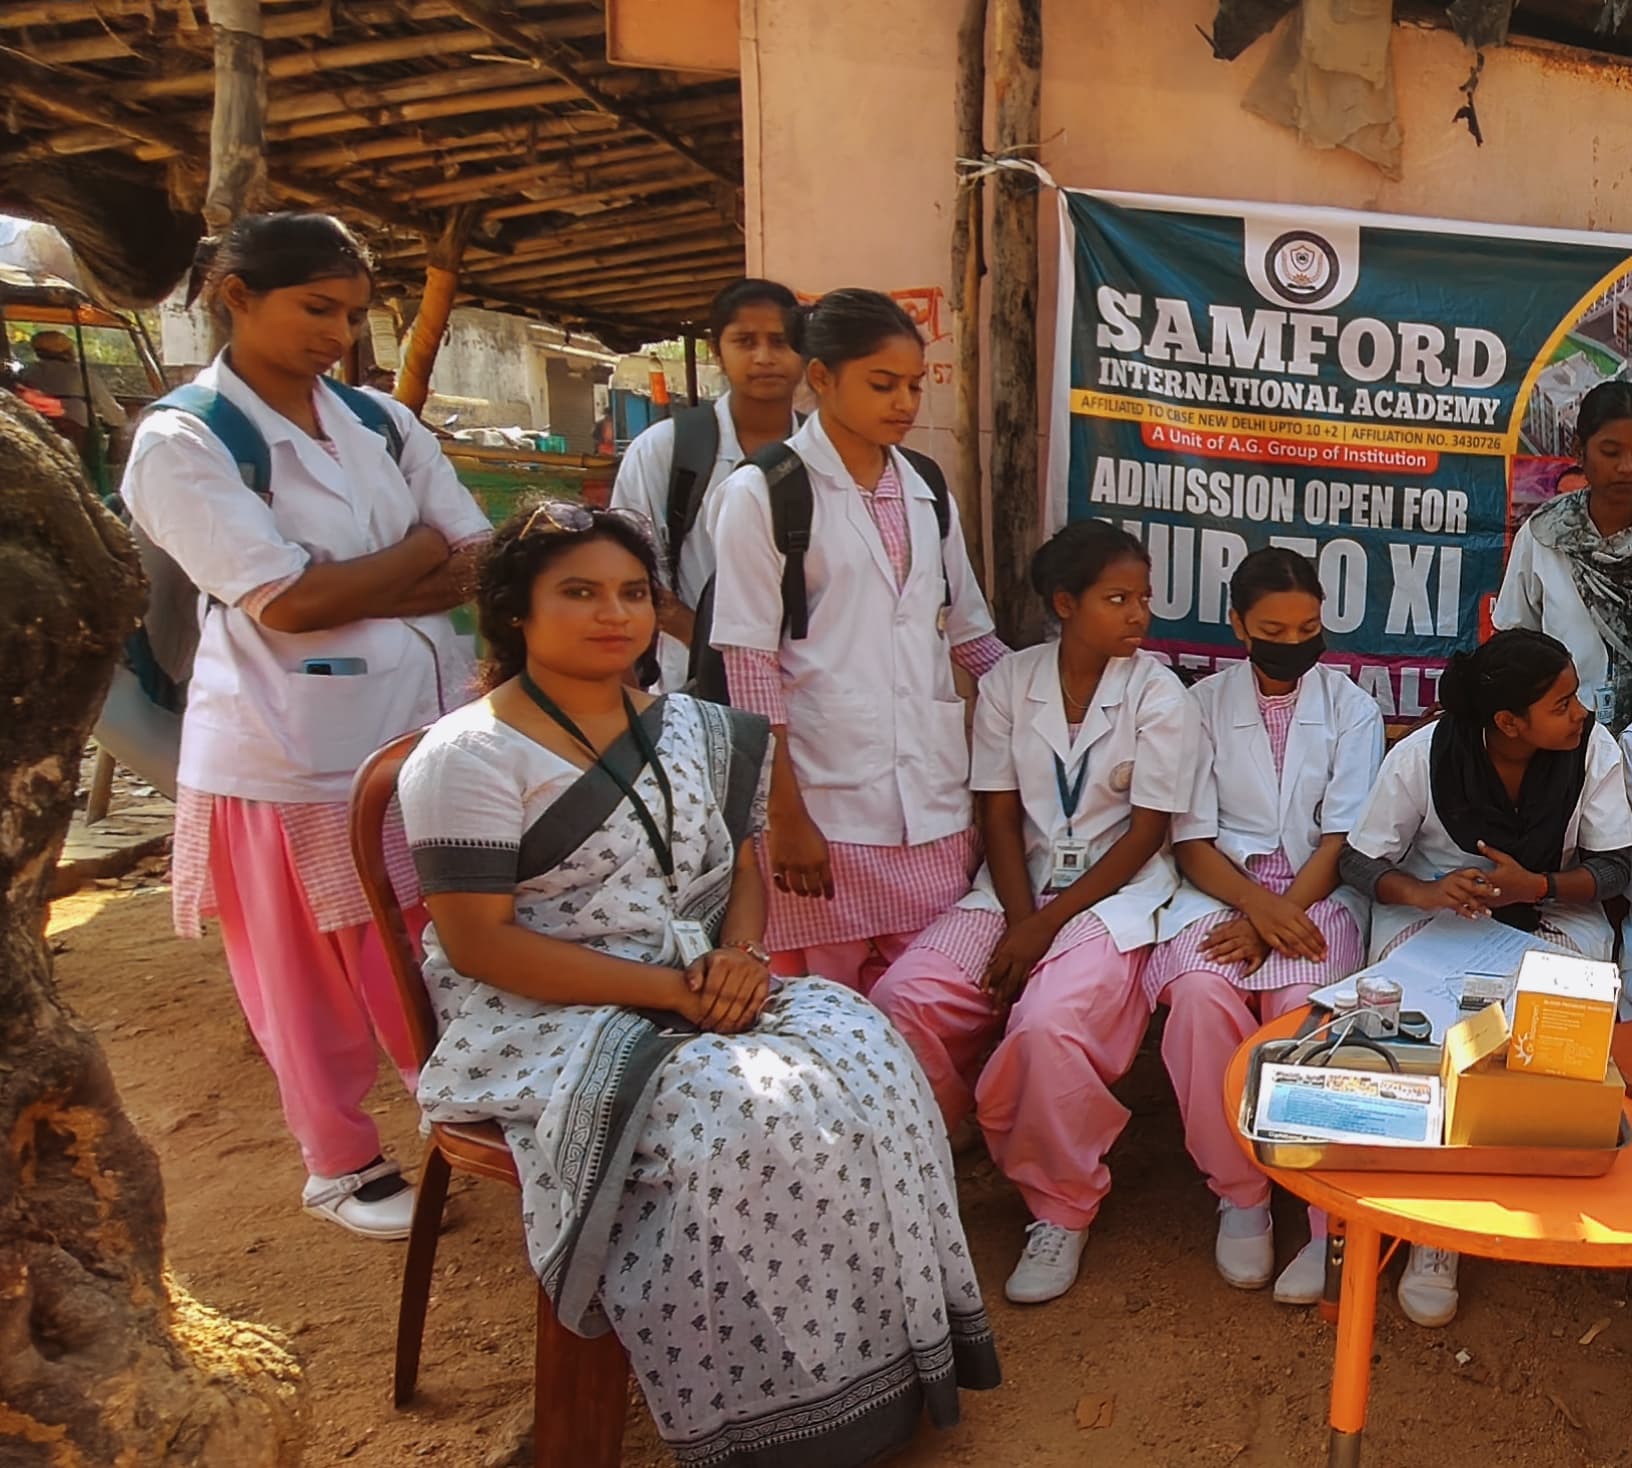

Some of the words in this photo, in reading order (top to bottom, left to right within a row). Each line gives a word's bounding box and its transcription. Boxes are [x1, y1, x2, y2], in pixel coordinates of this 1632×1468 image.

[1096, 284, 1507, 390] SAMFORD
[1081, 395, 1144, 416] AFFILIATED
[1147, 404, 1164, 418] TO
[1167, 408, 1194, 425] CBSE
[1199, 413, 1228, 428] NEW
[1232, 417, 1266, 433] DELHI
[1269, 421, 1302, 434] UPTO
[1306, 423, 1321, 436] 10
[1324, 425, 1338, 438] +2
[1352, 428, 1423, 444] AFFILIATION
[1427, 434, 1448, 447] NO.
[1452, 435, 1500, 450] 3430726
[1098, 357, 1344, 415] INTERNATIONAL
[1351, 388, 1500, 425] ACADEMY
[1152, 426, 1165, 440] A
[1169, 427, 1202, 448] Unit
[1207, 436, 1224, 450] of
[1228, 437, 1262, 453] A.G.
[1268, 441, 1317, 460] Group
[1323, 446, 1340, 461] of
[1344, 447, 1426, 467] Institution
[1091, 456, 1297, 523] ADMISSION
[1304, 480, 1393, 529] OPEN
[1403, 487, 1469, 534] FOR
[1092, 516, 1249, 625] UR
[1385, 543, 1463, 637] XI
